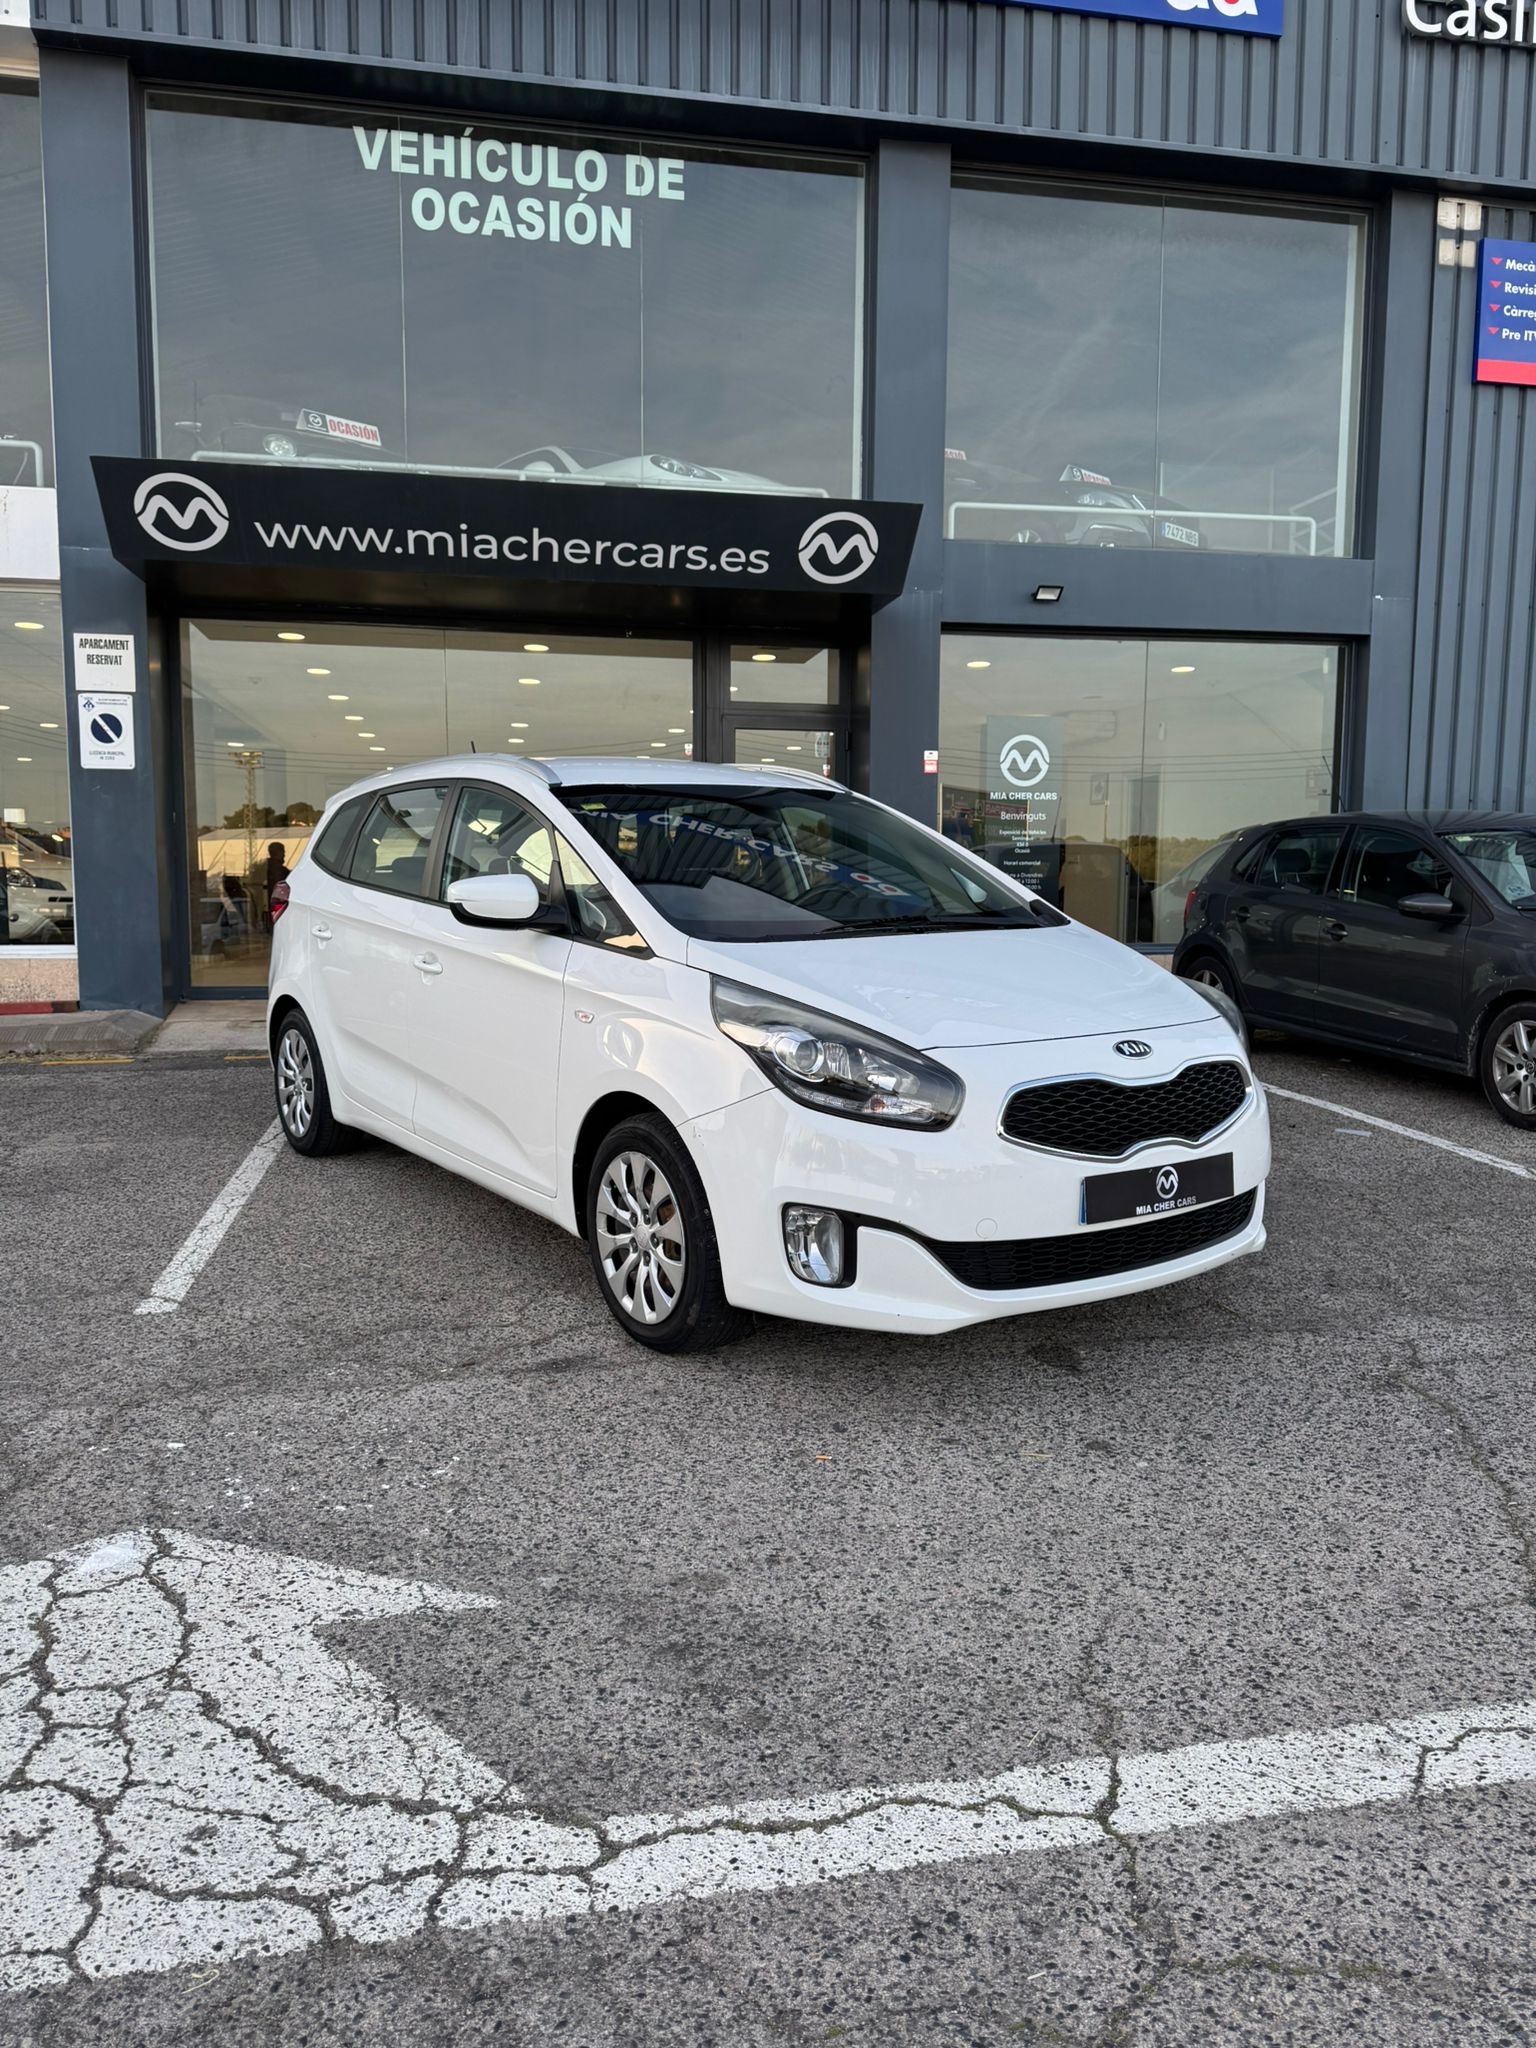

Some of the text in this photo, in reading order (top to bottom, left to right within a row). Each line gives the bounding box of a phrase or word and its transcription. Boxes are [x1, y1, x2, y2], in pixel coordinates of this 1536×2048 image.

[352, 125, 686, 201] VEHÍCULO DE
[410, 187, 632, 249] OCASIÓN
[1502, 327, 1521, 340] Pre
[328, 418, 379, 442] OCASIÓN
[253, 521, 771, 576] www.miachercars.es
[79, 637, 130, 651] APARCAMENT
[86, 653, 123, 666] RESERVAT
[990, 792, 1057, 800] MIA CHER CARS
[1000, 811, 1047, 822] Benvinguts
[1117, 1041, 1151, 1056] KIA
[1136, 1196, 1197, 1215] MIA CHER CARS
